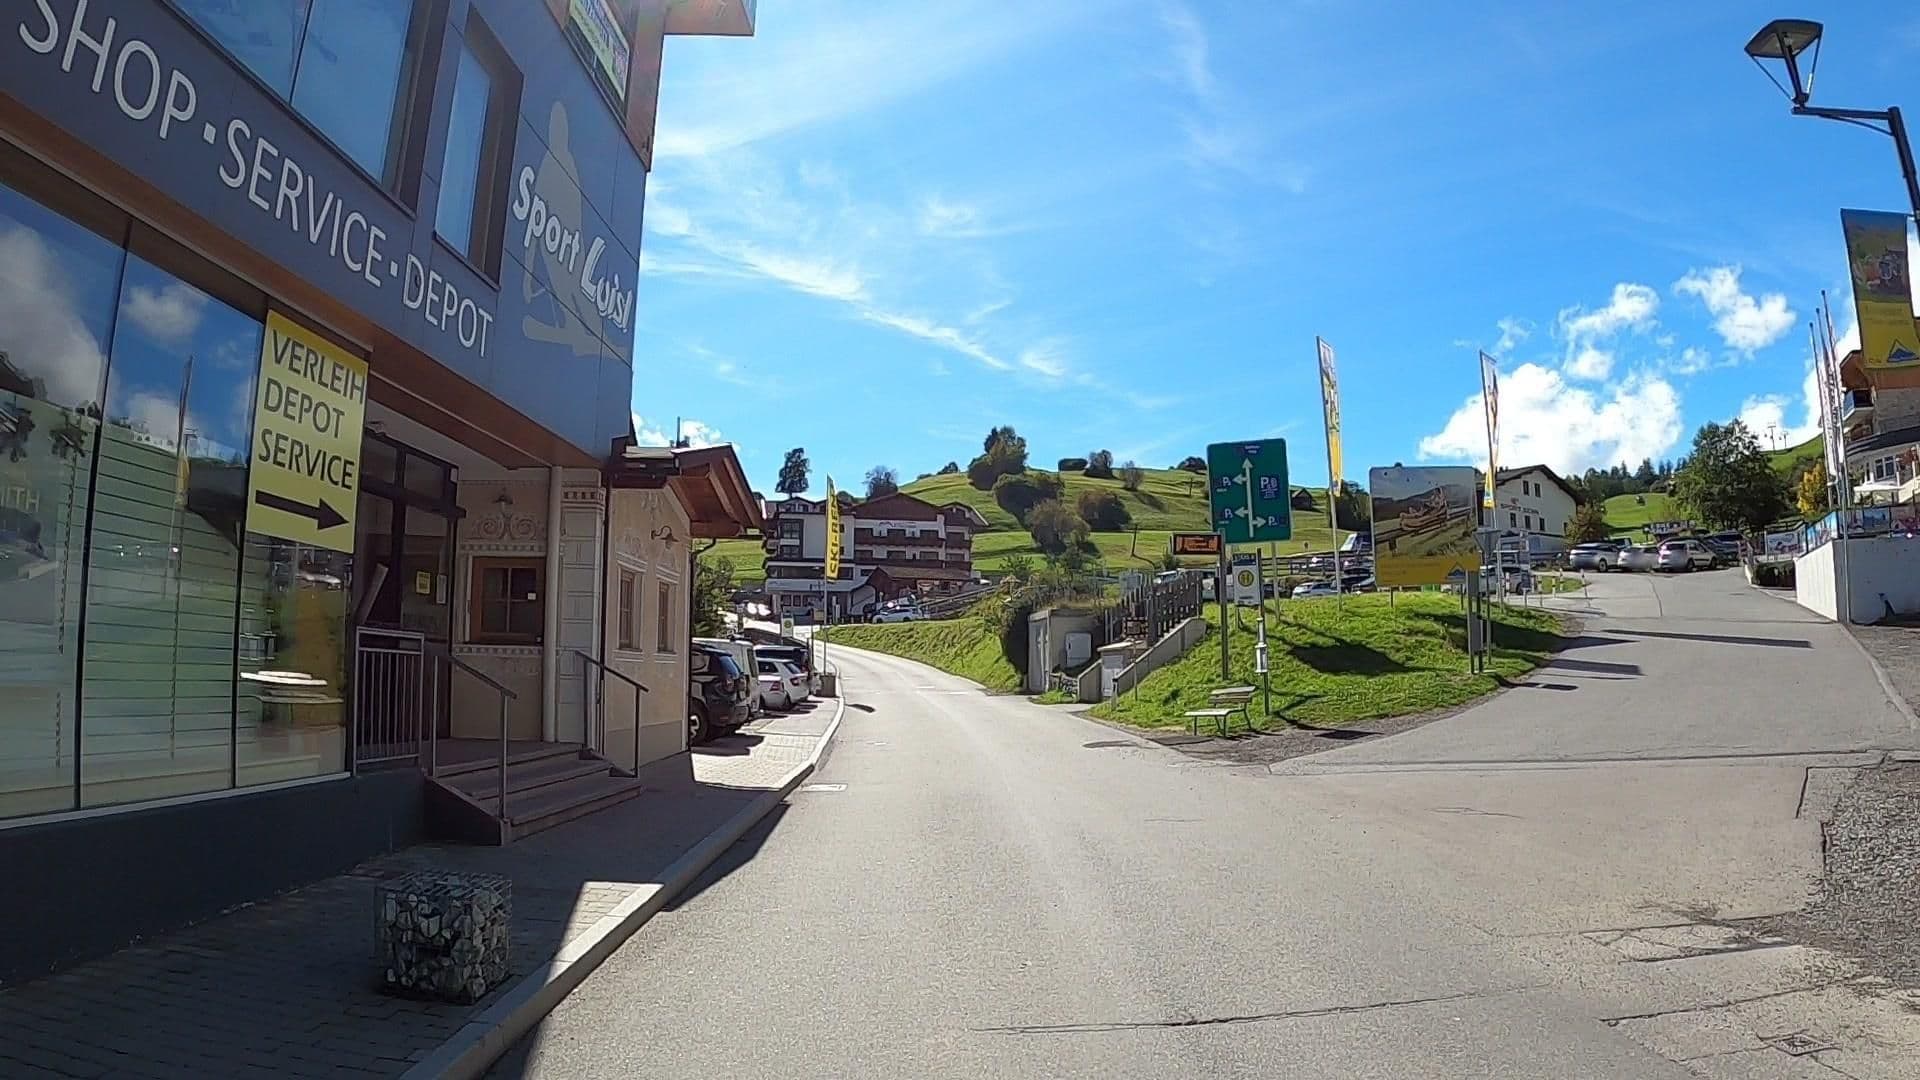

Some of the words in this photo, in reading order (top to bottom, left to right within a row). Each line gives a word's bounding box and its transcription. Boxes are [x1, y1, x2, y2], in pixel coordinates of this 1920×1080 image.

[19, 0, 196, 139] SHOP
[219, 118, 387, 288] SERVICE
[403, 253, 494, 358] DEPOT
[513, 166, 580, 273] Sport
[272, 328, 367, 405] VERLEIH
[264, 377, 346, 439] DEPOT
[258, 428, 355, 490] SERVICE
